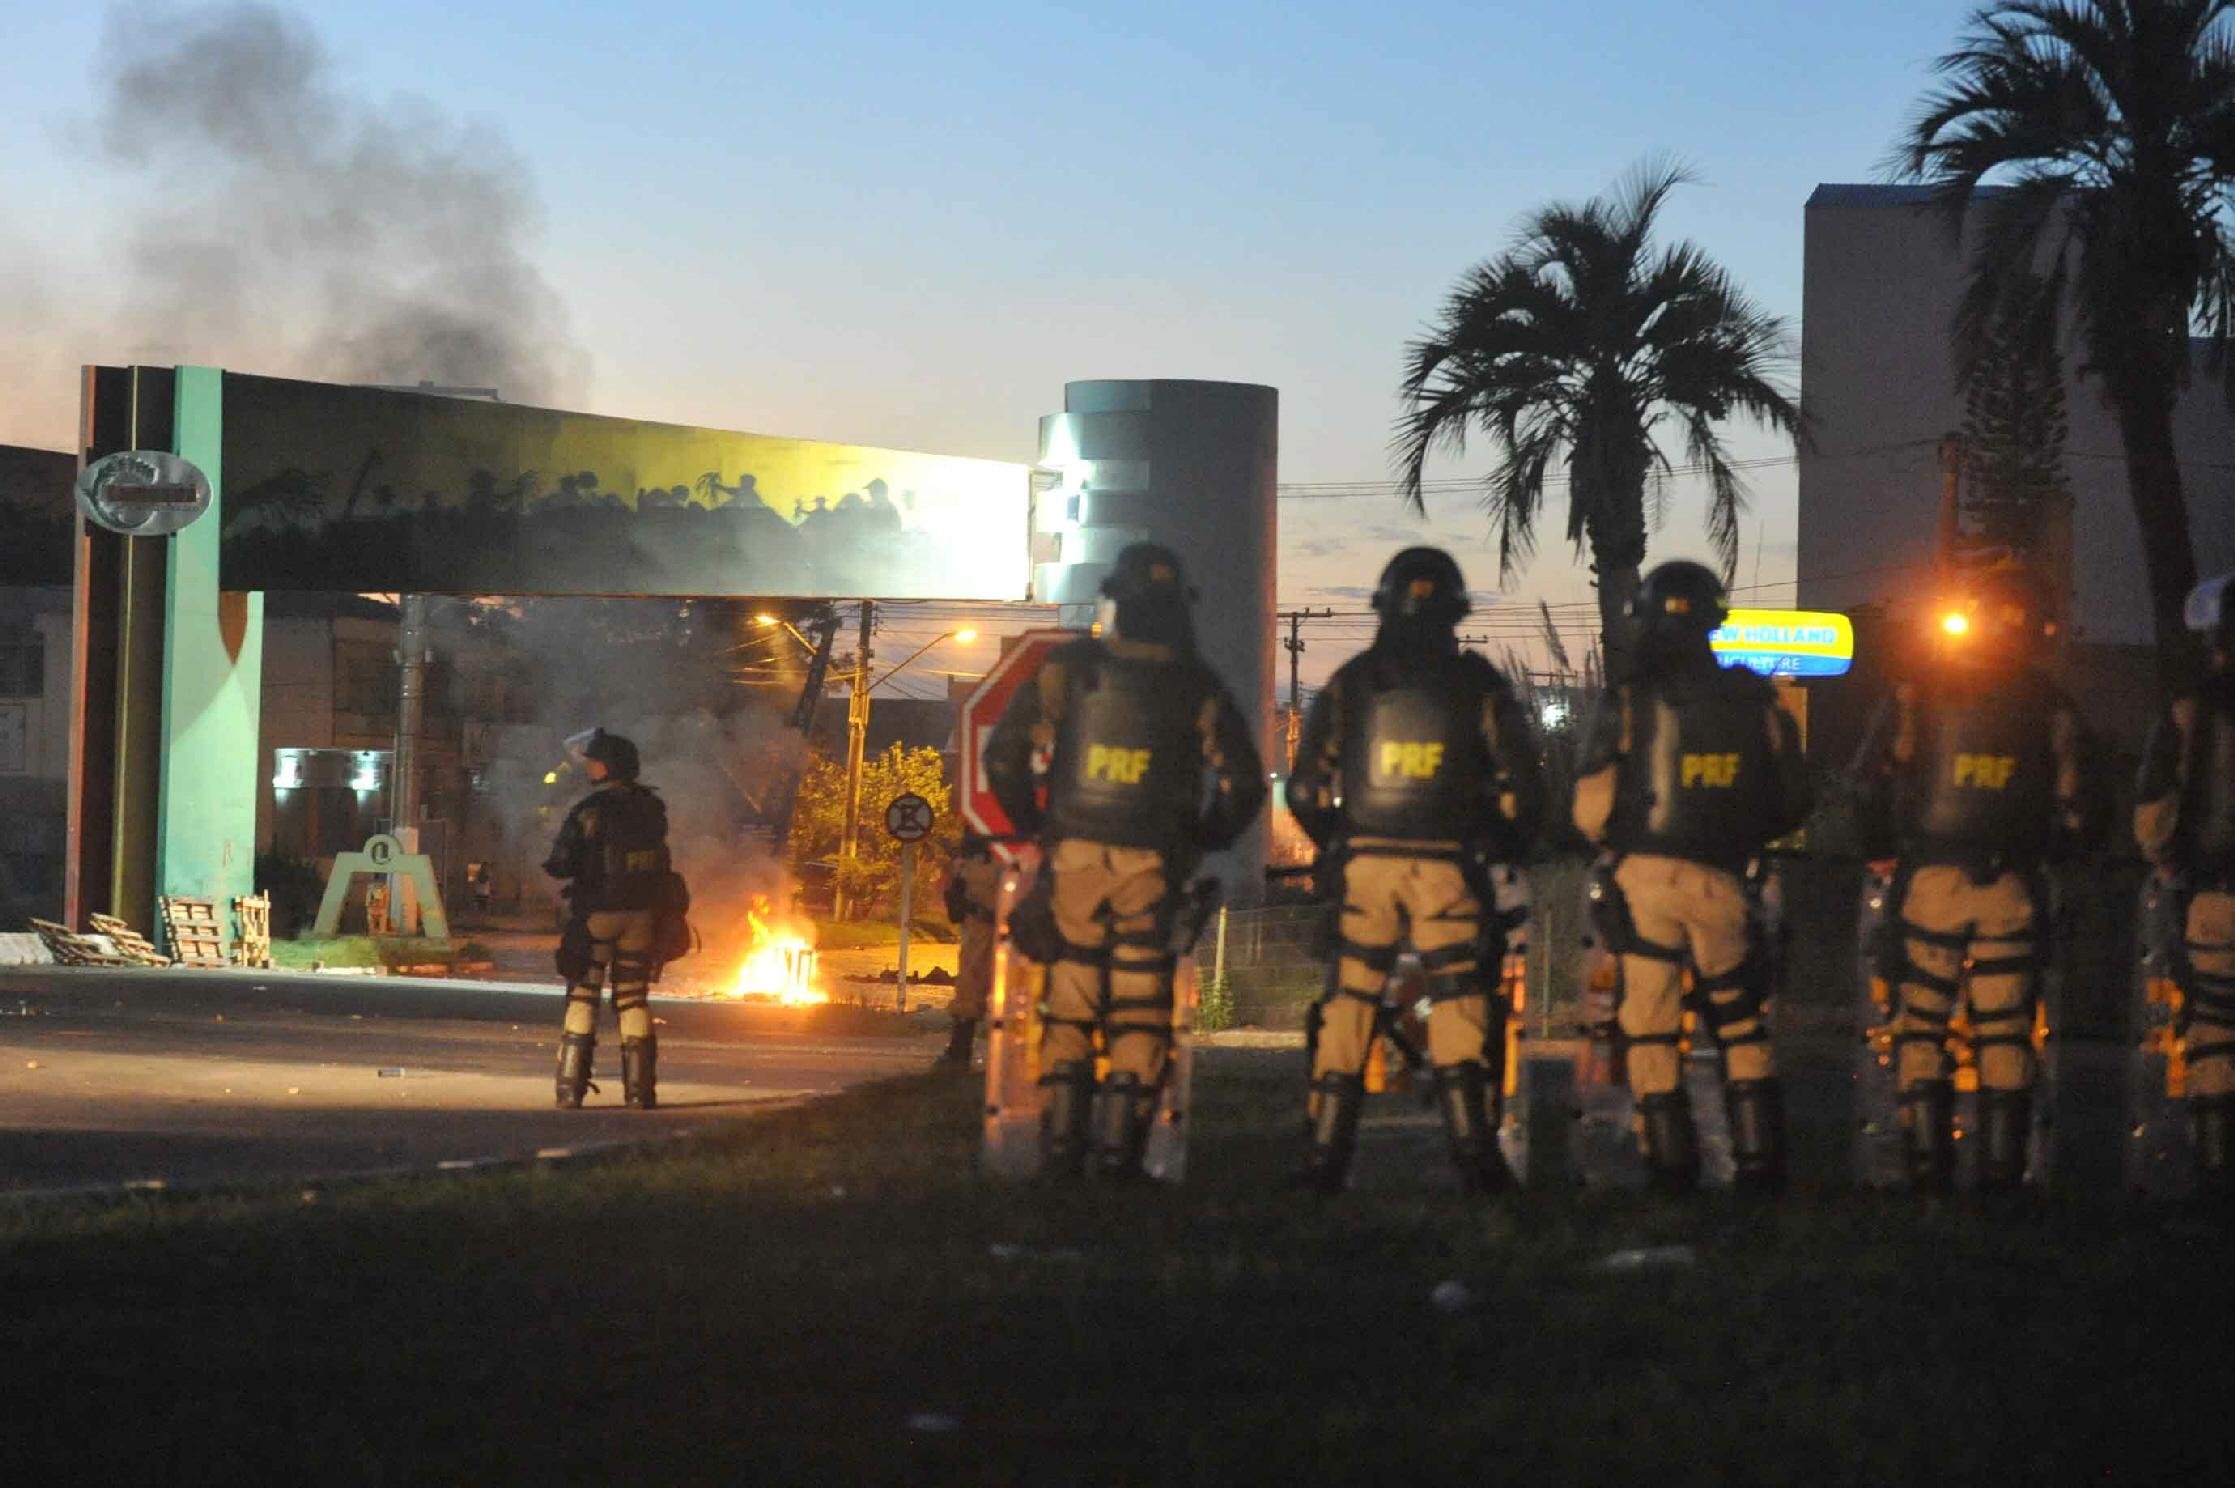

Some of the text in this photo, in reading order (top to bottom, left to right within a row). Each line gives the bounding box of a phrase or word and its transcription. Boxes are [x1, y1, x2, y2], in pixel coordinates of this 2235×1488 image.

[1743, 625, 1837, 645] HOLLAND
[1088, 743, 1152, 784] PRF
[1380, 740, 1445, 778] PRF
[1682, 753, 1740, 788] PRF
[1954, 753, 2016, 788] PRF
